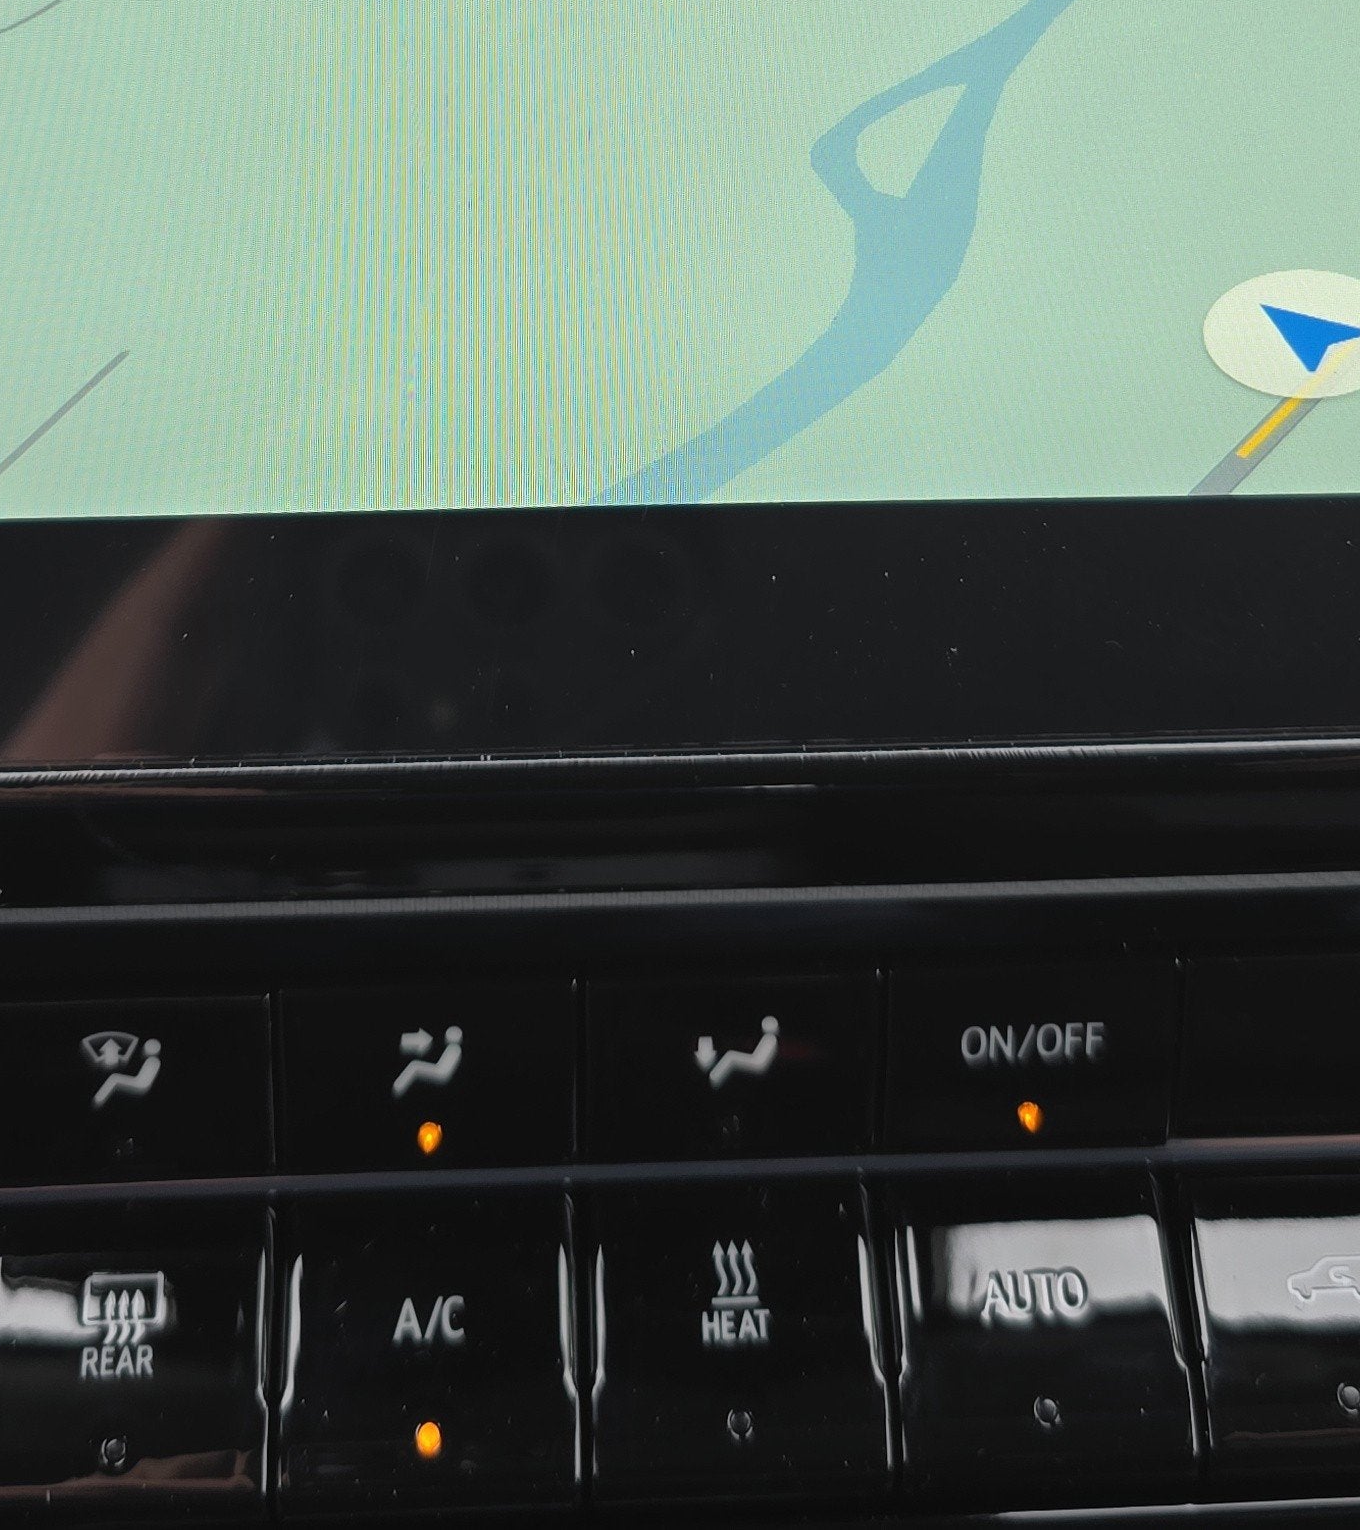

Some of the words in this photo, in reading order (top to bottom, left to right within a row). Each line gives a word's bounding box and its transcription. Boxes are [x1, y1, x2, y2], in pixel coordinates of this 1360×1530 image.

[960, 1020, 1105, 1063] ON/OFF
[980, 1266, 1089, 1323] AUTO
[393, 1295, 466, 1344] A/C
[701, 1307, 770, 1341] HEAT
[80, 1344, 155, 1378] REAR
